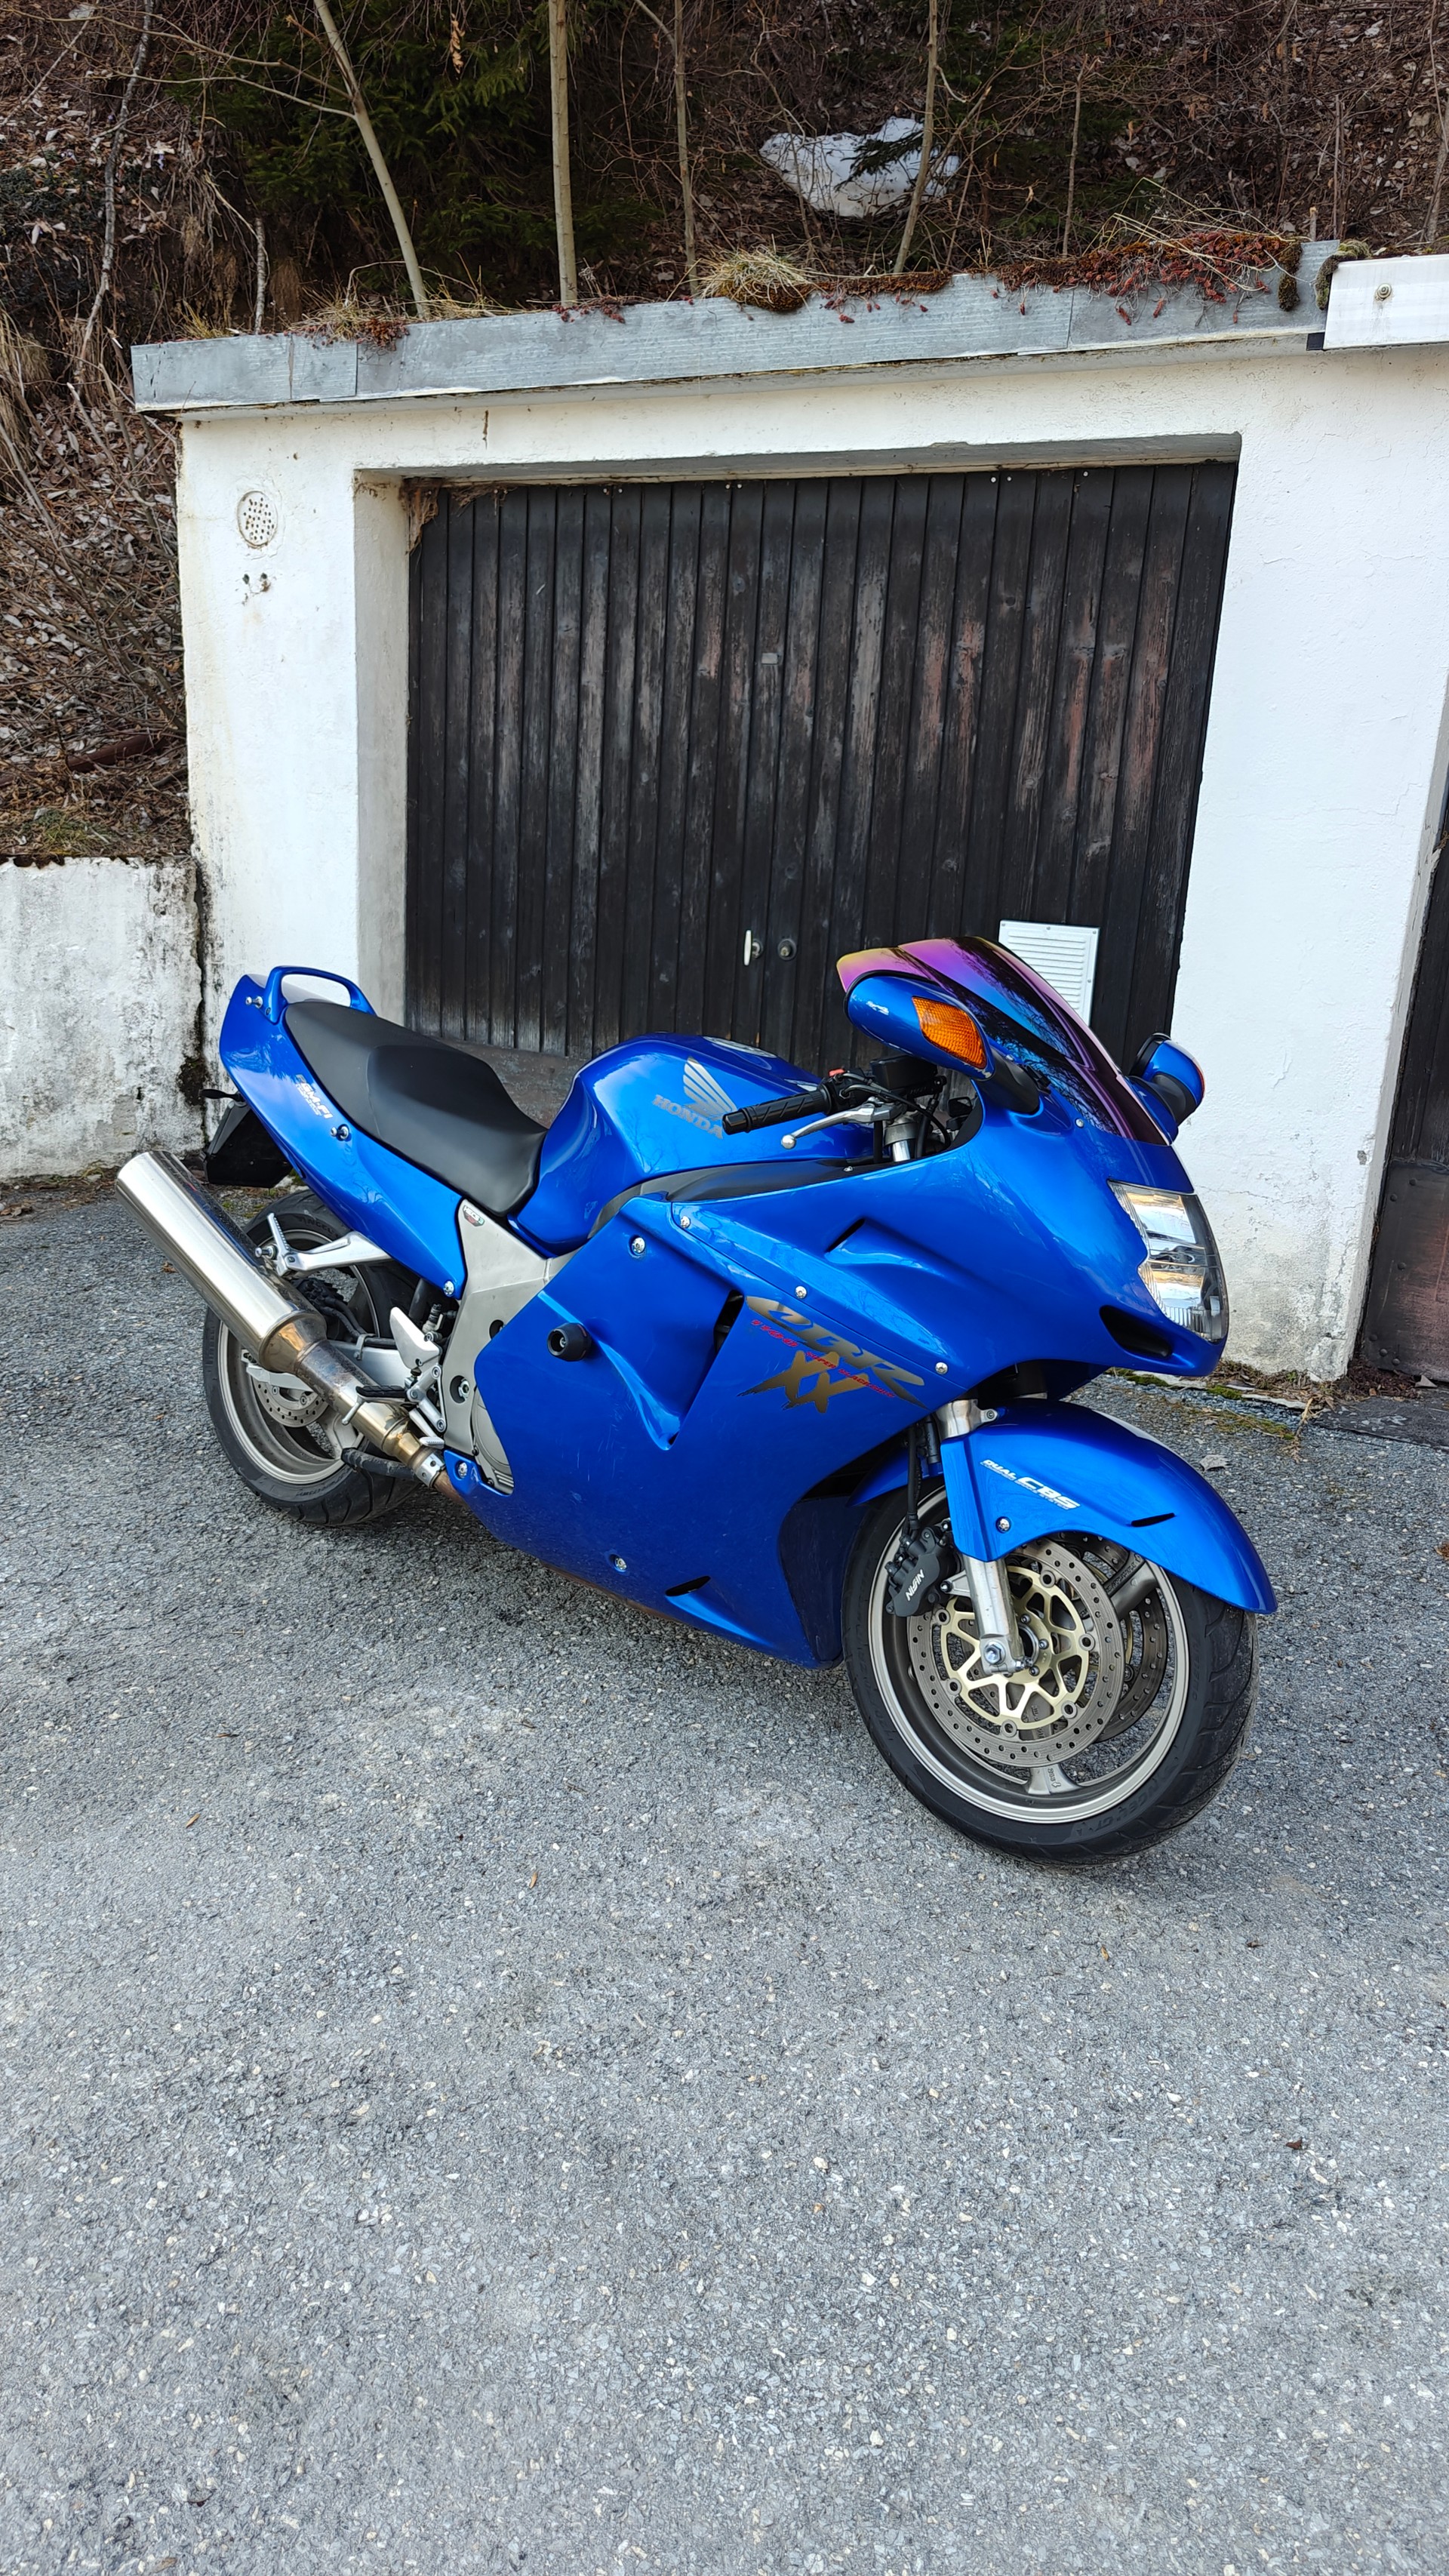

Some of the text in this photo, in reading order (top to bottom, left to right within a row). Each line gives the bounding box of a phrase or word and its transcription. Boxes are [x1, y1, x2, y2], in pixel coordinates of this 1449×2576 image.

[652, 1094, 724, 1139] HONDA
[746, 1296, 929, 1410] CBR
[805, 1351, 837, 1370] SUPER
[737, 1350, 870, 1414] XX
[982, 1459, 1081, 1509] DUAL CBS
